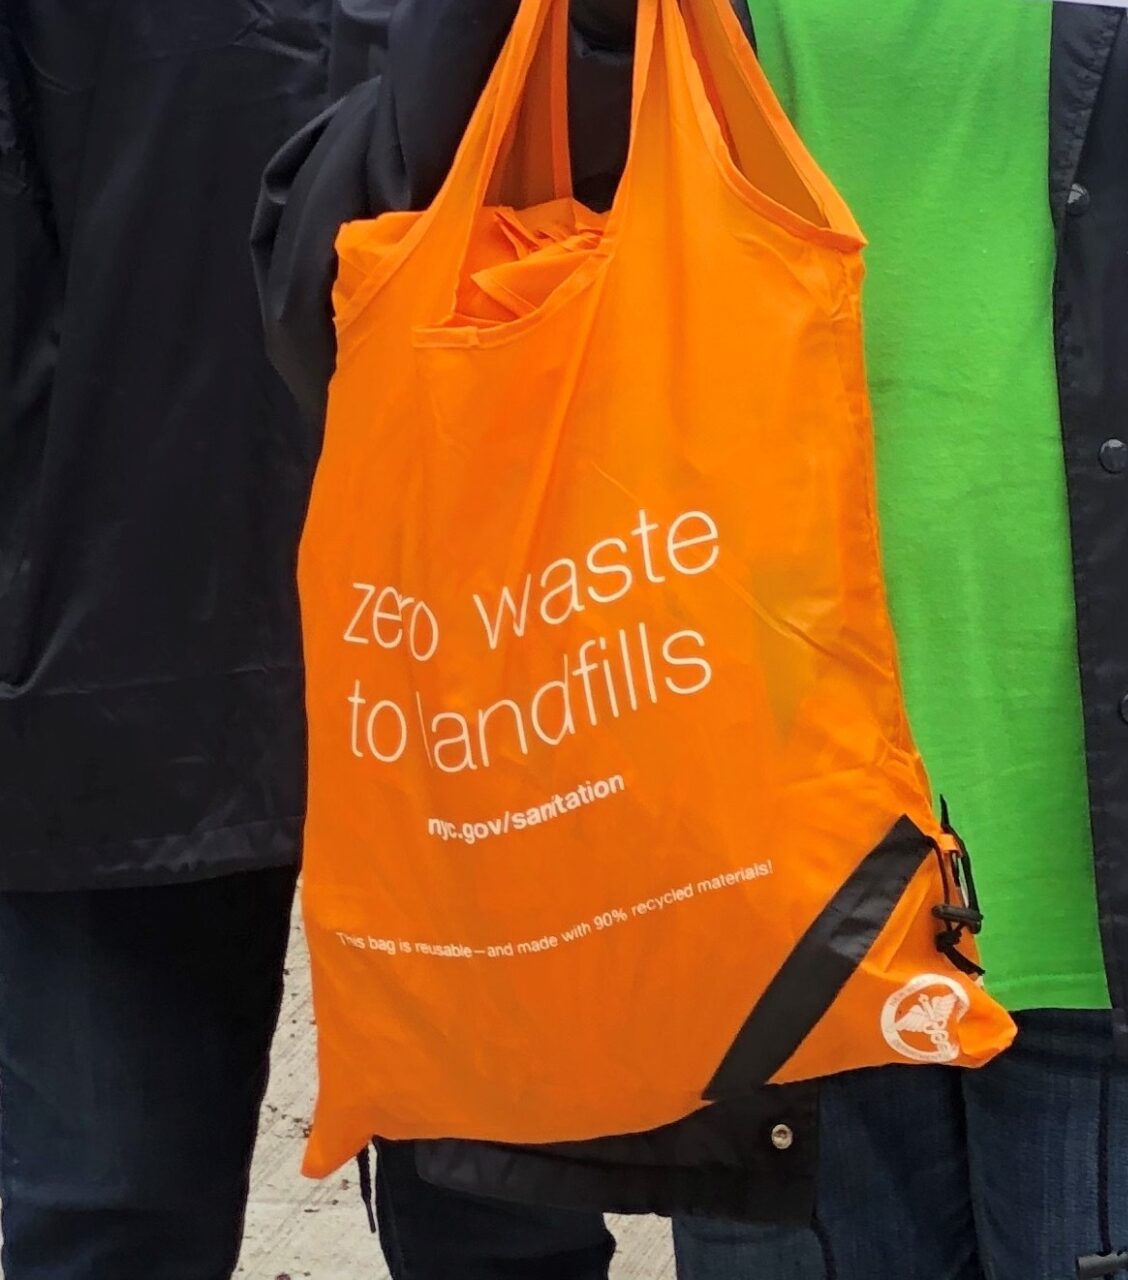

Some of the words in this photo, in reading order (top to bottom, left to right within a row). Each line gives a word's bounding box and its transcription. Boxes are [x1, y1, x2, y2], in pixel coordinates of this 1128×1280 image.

[343, 582, 439, 662] zero
[473, 509, 720, 650] waste
[347, 679, 408, 763] to
[415, 622, 713, 773] landfills
[428, 774, 625, 845] nyc.gov/sanitation
[336, 932, 366, 949] This
[367, 935, 397, 956] bag
[398, 938, 412, 953] is
[517, 934, 559, 955] made
[561, 922, 592, 943] with
[593, 908, 628, 931] 90%
[631, 883, 695, 917] recycled
[697, 859, 774, 894] materials!
